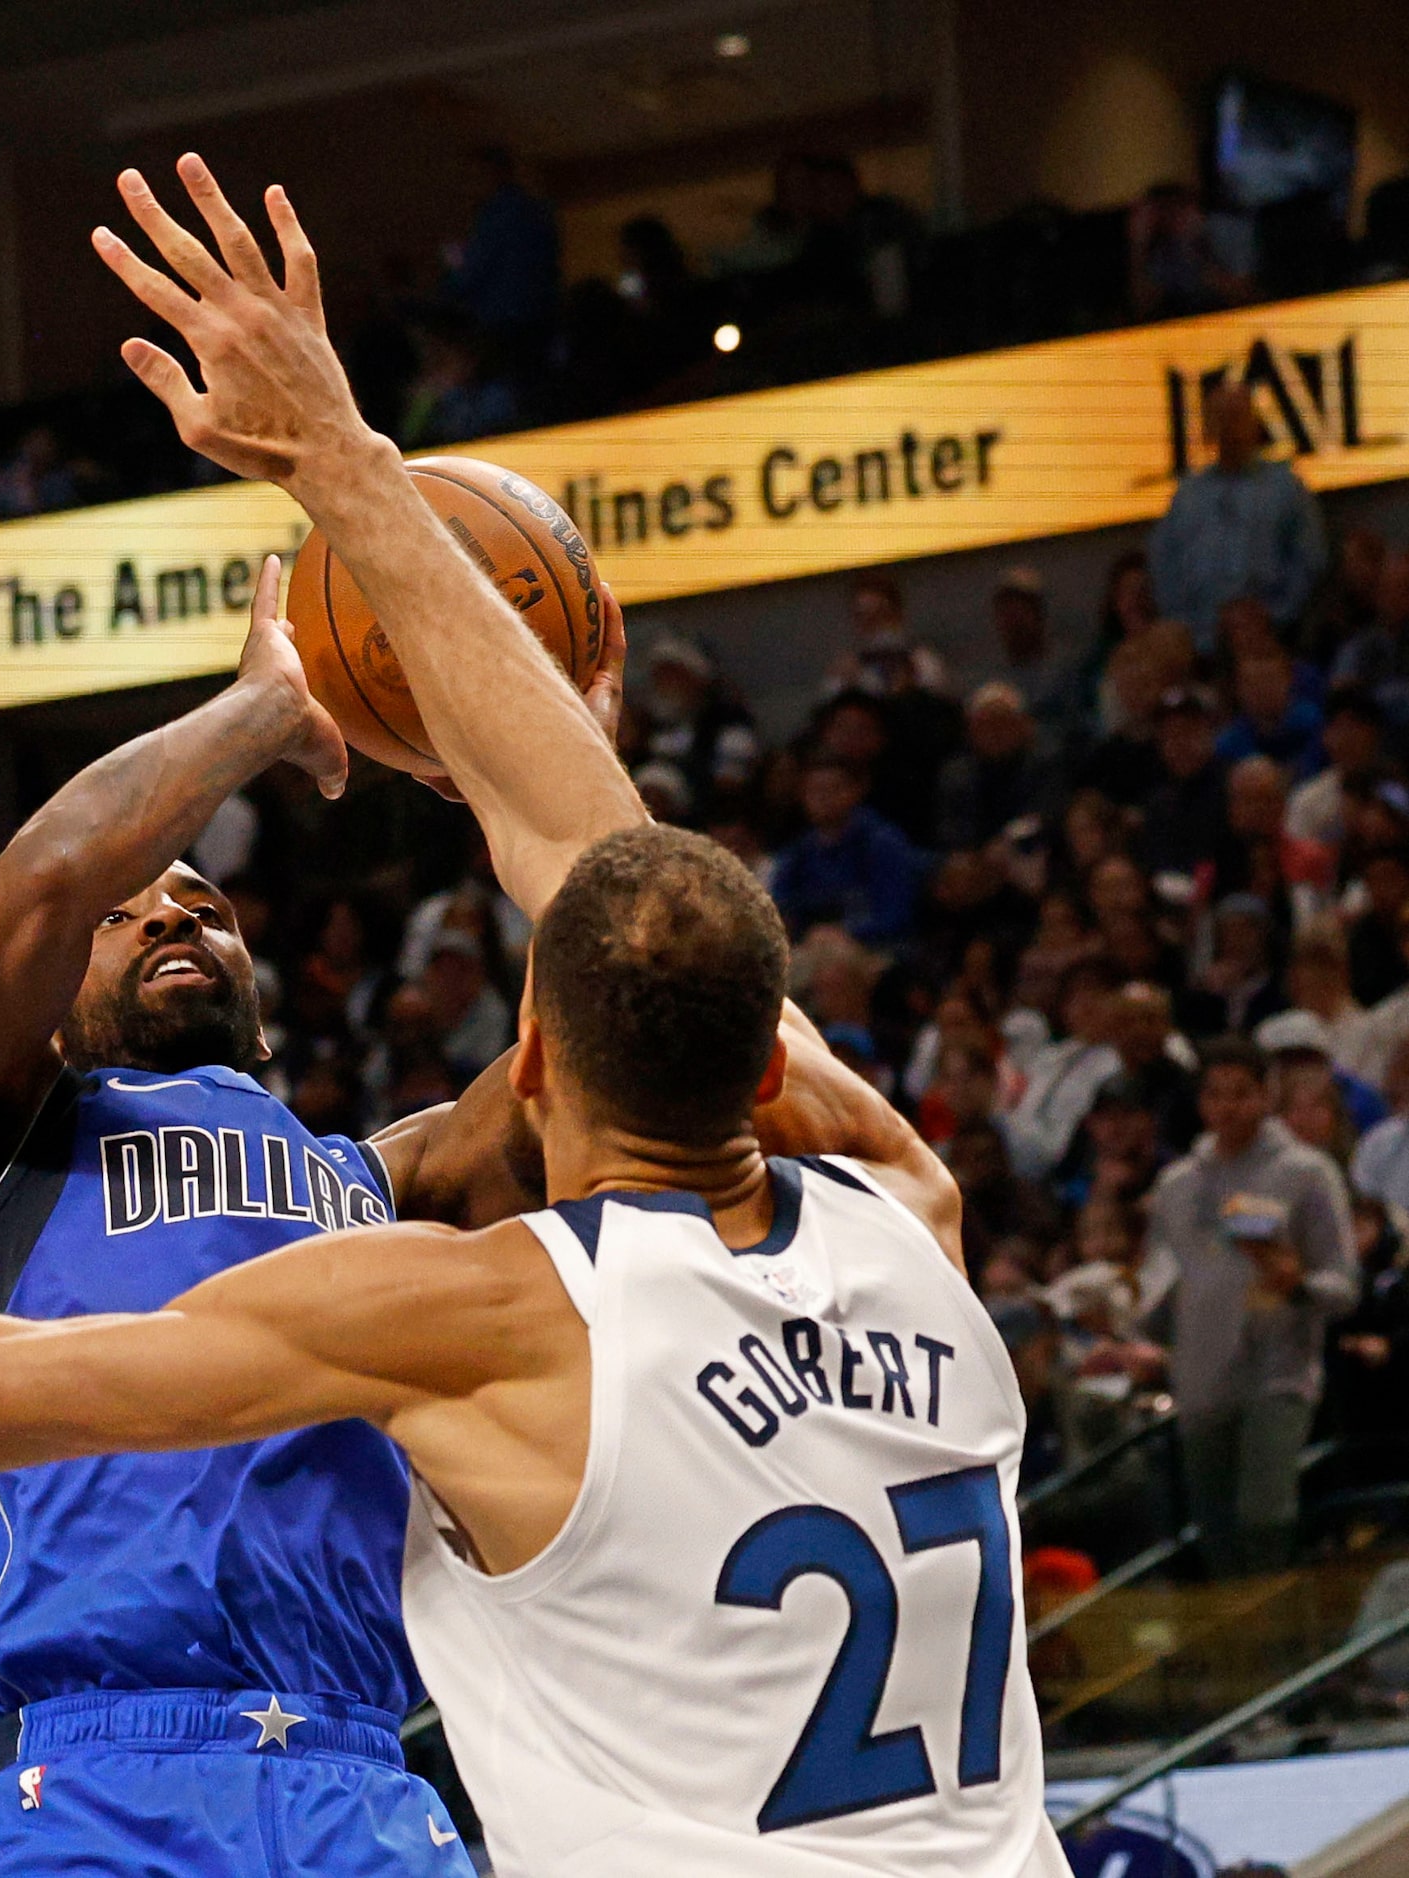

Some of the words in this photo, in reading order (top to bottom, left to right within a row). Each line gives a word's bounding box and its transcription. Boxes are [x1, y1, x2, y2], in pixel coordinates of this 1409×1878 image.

[564, 468, 735, 553] lines
[760, 426, 1002, 519] Center
[696, 1315, 956, 1449] GOBERT
[713, 1462, 1016, 1836] 27
